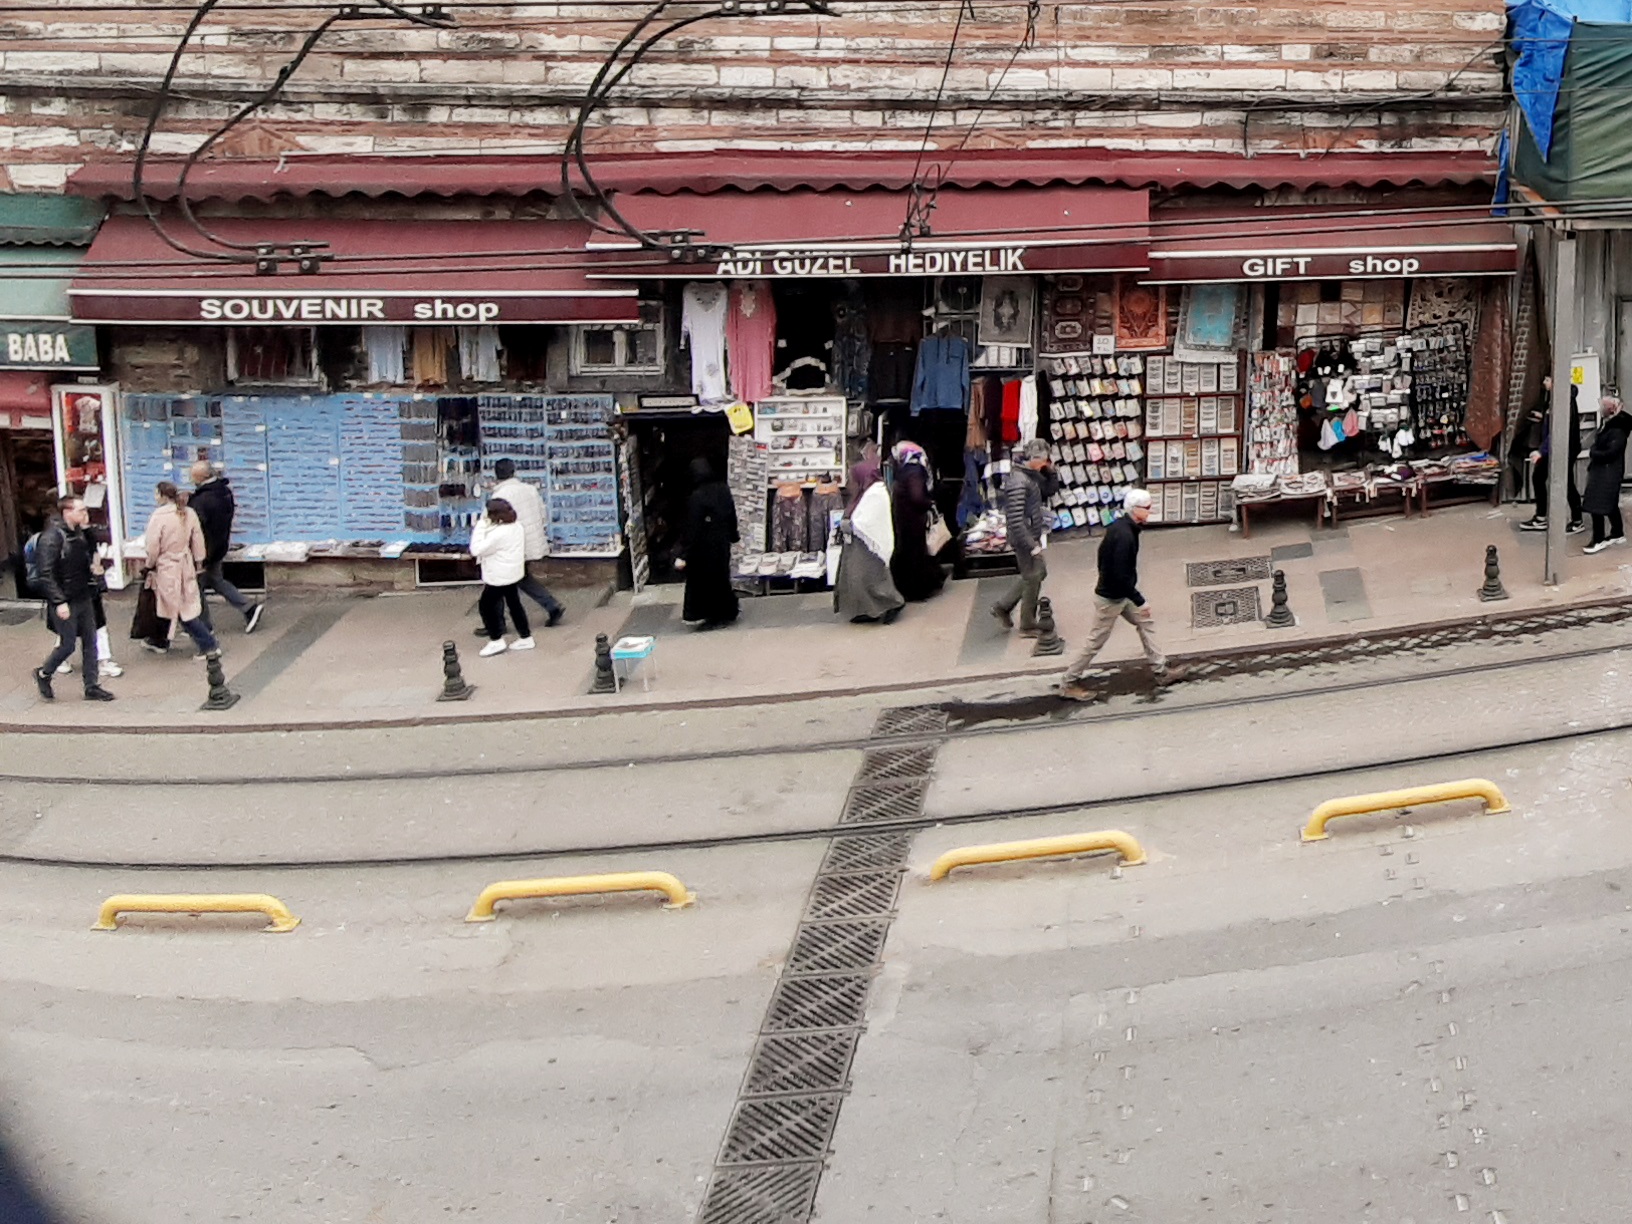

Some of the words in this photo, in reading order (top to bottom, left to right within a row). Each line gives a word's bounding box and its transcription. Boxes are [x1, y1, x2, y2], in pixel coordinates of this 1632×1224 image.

[716, 250, 762, 275] ADI
[1242, 257, 1313, 276] GIFT
[1348, 255, 1420, 276] shop
[200, 298, 385, 319] SOUVENIR
[413, 298, 499, 322] shop
[7, 332, 71, 362] BABA
